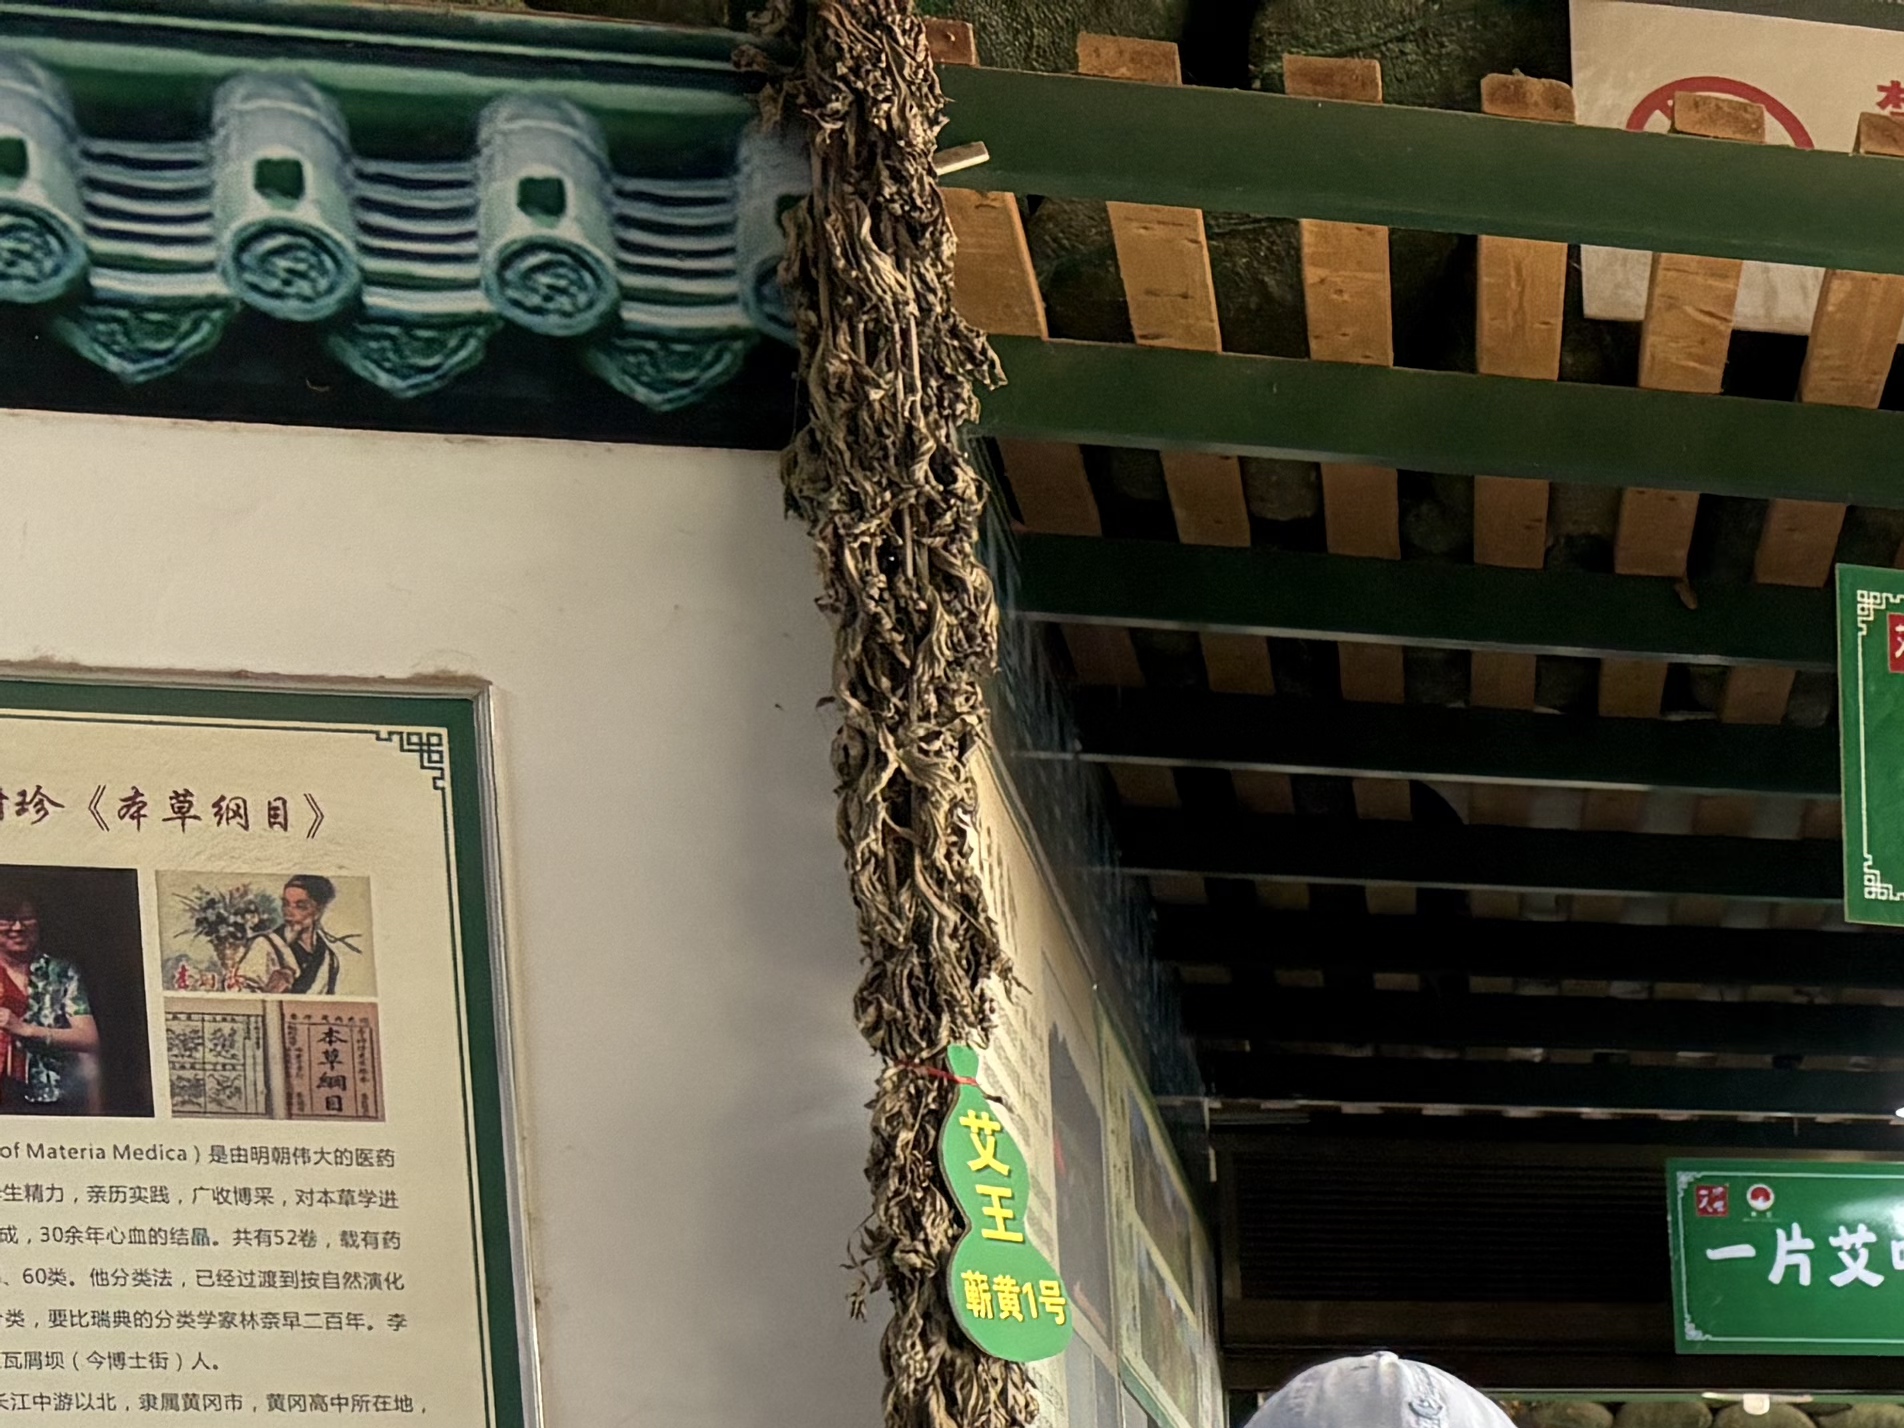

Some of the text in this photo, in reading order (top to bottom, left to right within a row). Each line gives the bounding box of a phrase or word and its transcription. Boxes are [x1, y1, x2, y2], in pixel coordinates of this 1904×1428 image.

[0, 784, 325, 840] 珍《本草纲目》
[26, 1143, 106, 1161] Materia
[113, 1144, 188, 1162] Medica
[959, 1108, 1025, 1243] 艾王
[0, 1183, 400, 1210] 生精力，亲历实践，广收博采，对本草学进
[960, 1269, 1067, 1326] 蕲黄1号
[0, 1308, 408, 1334] 类，要比瑞典的分类学家林奈早二百年。李
[0, 1350, 219, 1372] 瓦屑坝（今博士街）人。
